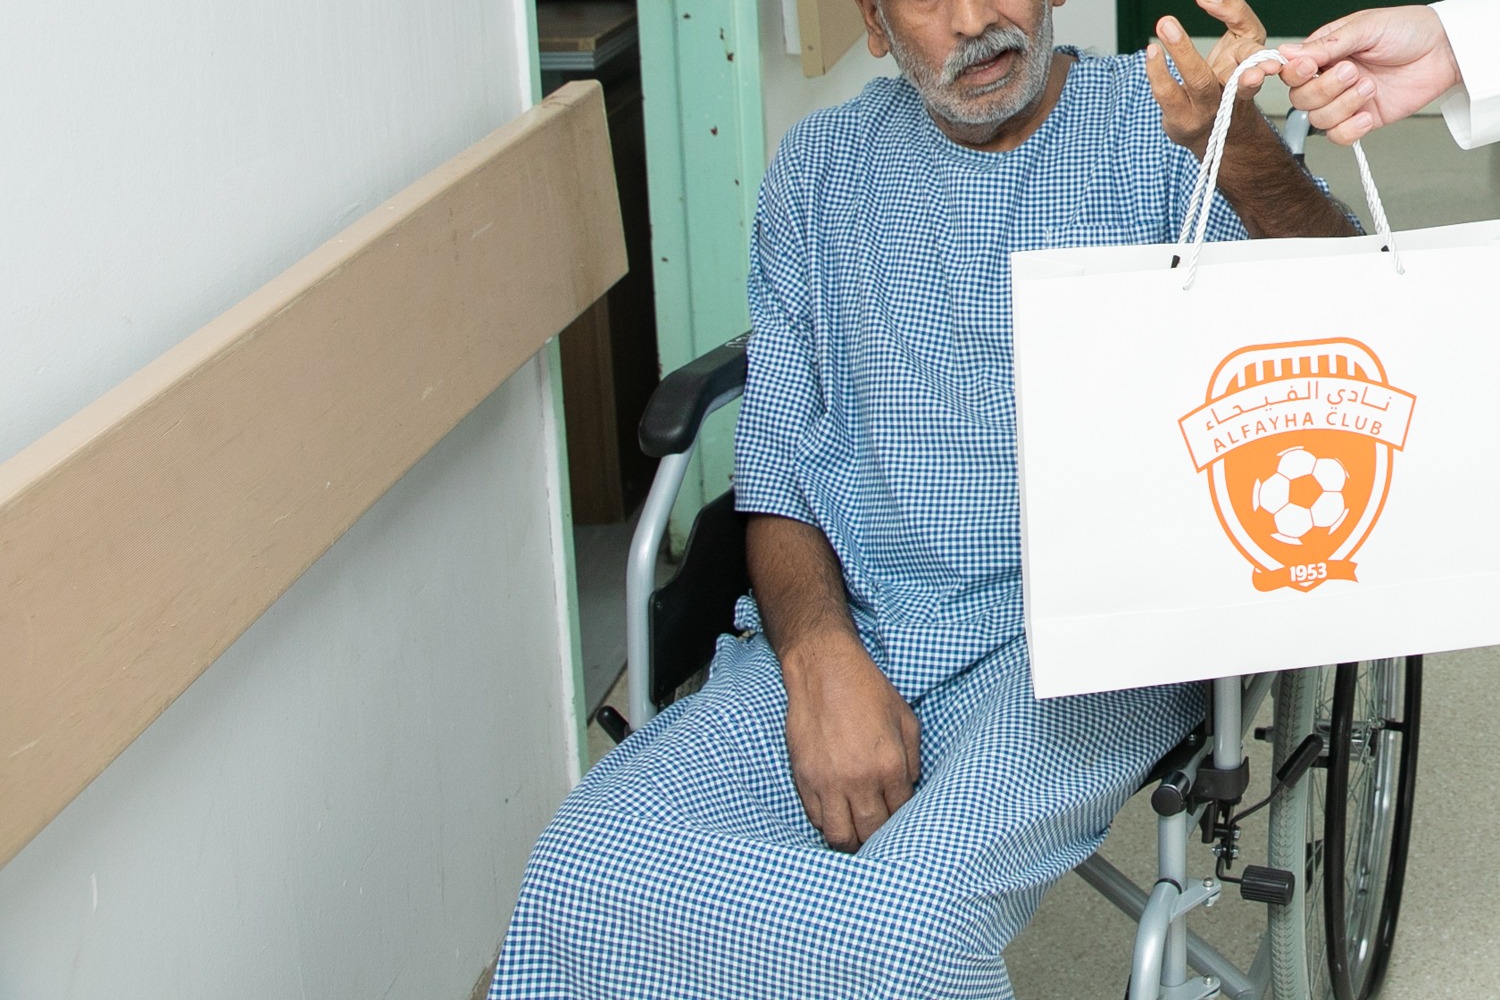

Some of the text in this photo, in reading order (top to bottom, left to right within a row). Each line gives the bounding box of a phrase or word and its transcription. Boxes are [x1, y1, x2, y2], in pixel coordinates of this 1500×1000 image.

[1206, 380, 1392, 431] نادي الفيحاء
[1213, 410, 1383, 454] ALFAYHA CLUB
[1289, 562, 1328, 583] 1953
